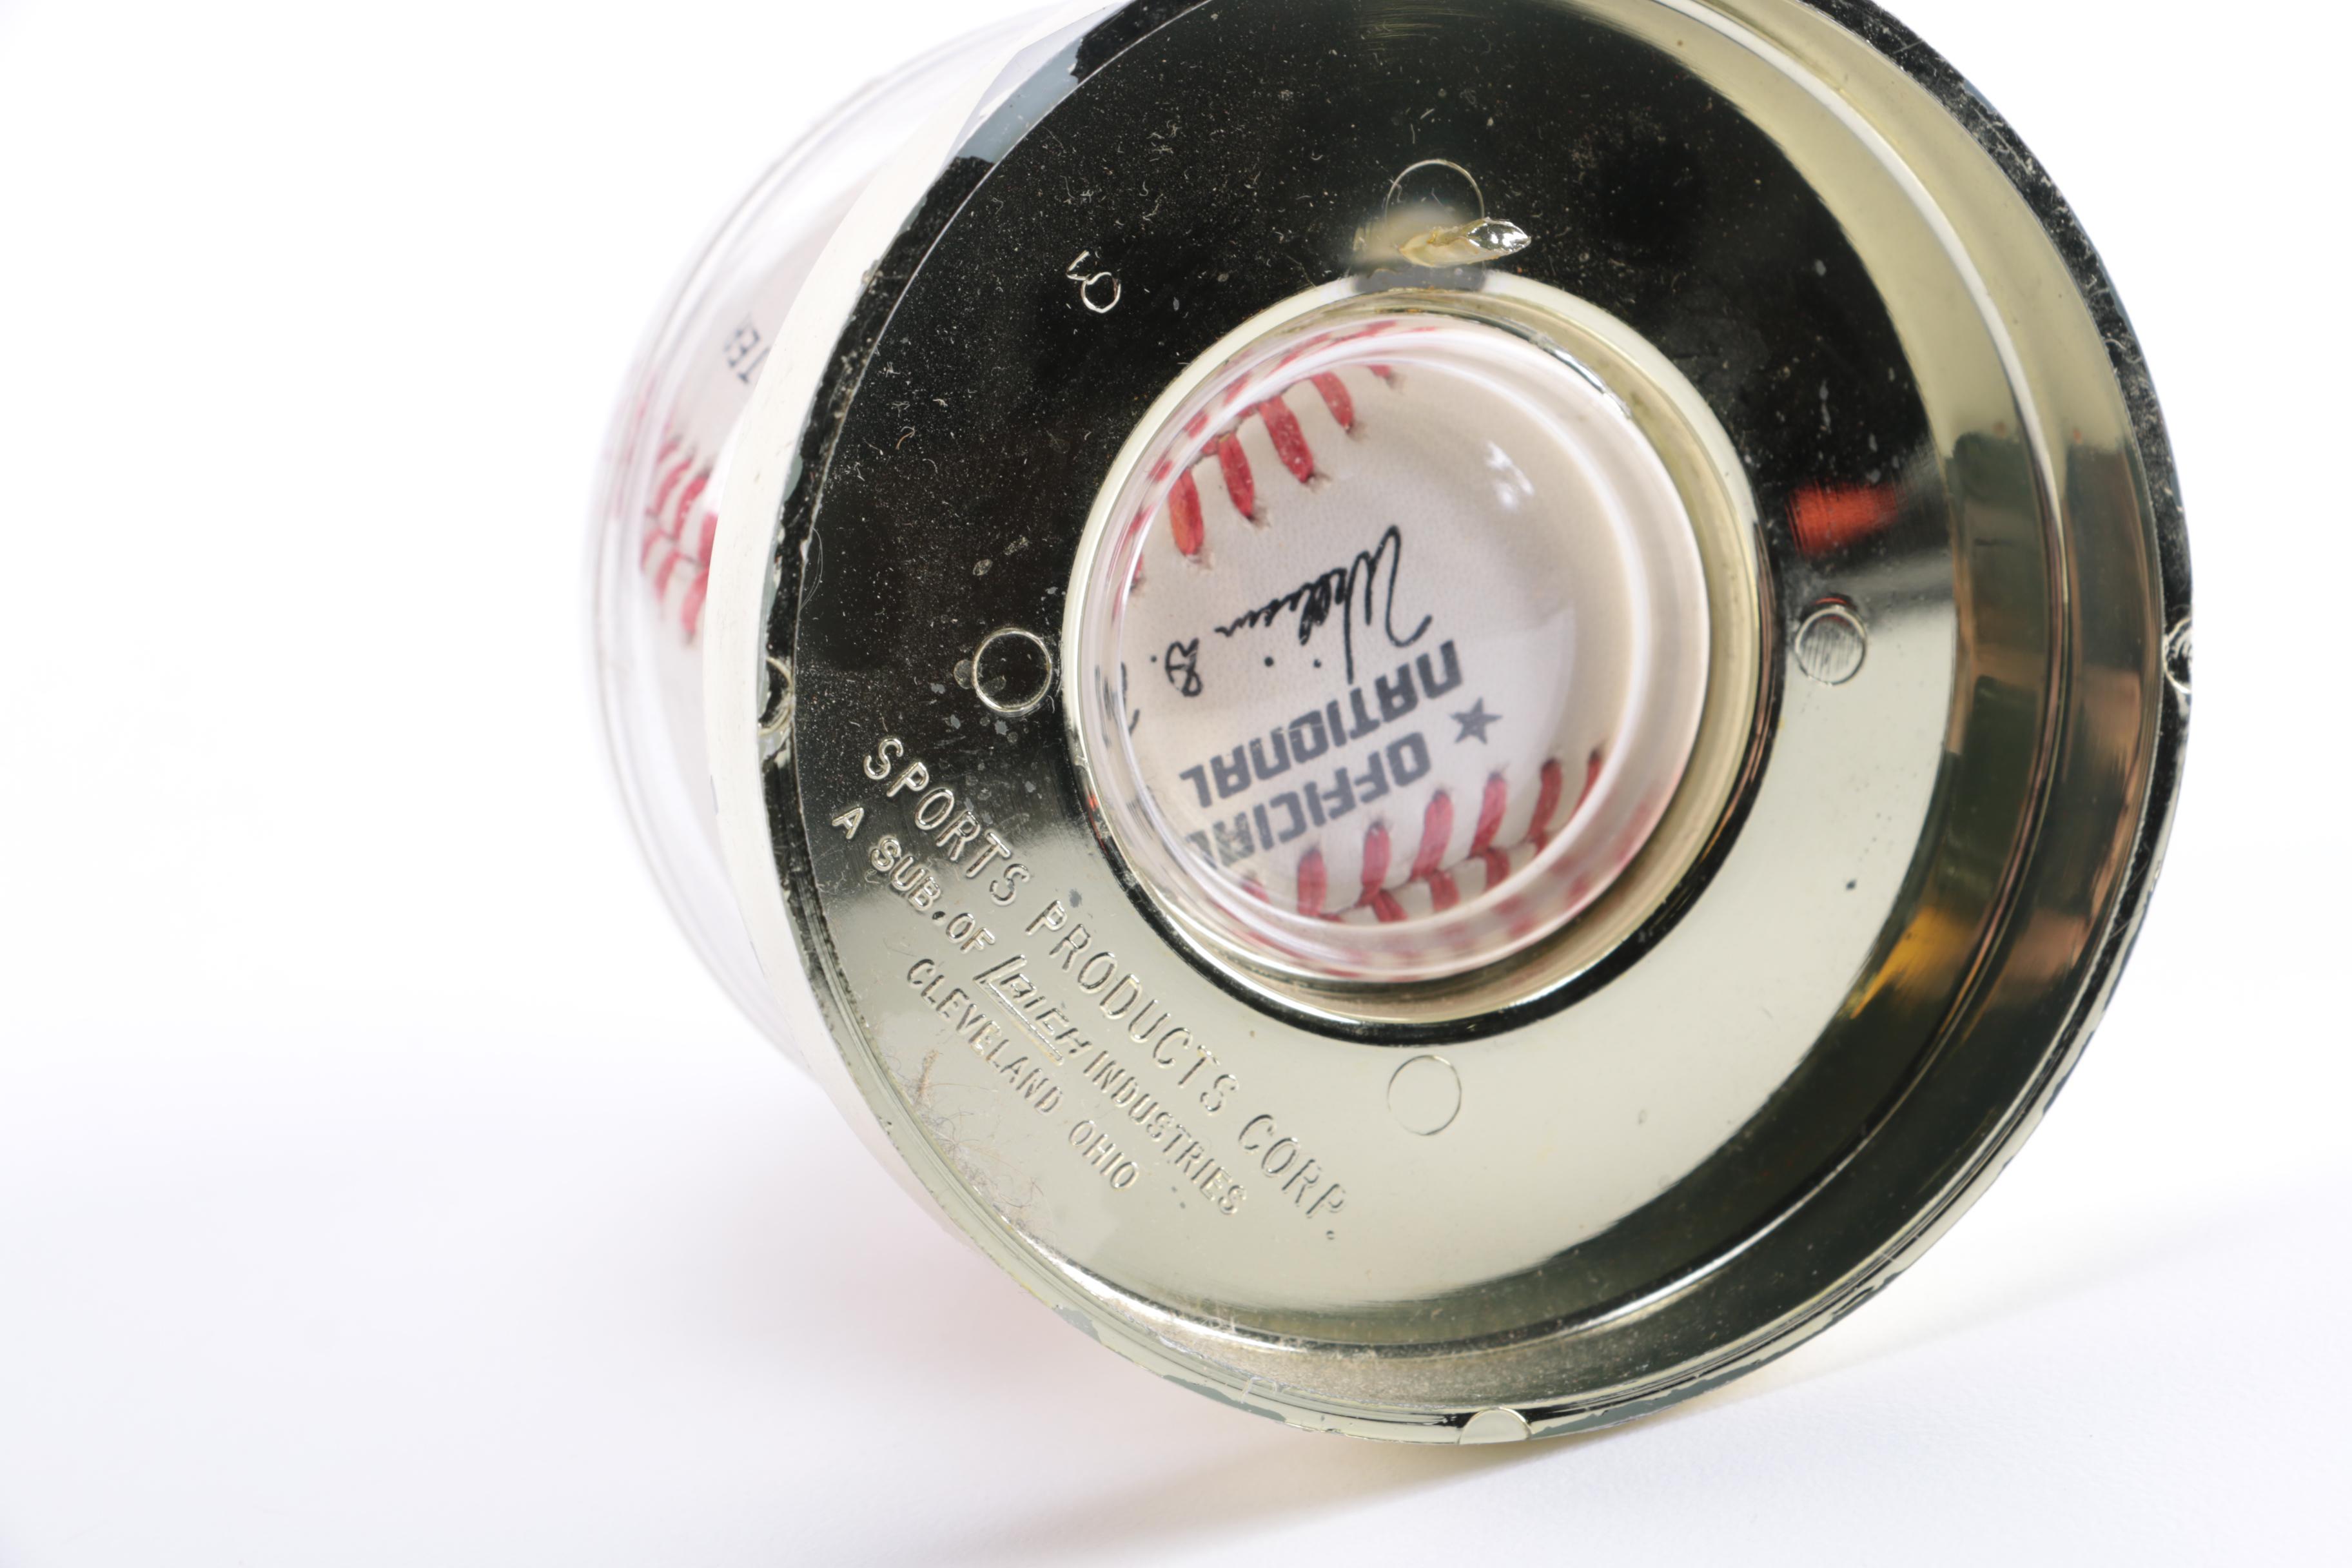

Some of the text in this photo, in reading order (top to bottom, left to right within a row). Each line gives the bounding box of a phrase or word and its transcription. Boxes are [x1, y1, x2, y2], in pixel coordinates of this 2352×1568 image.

[1179, 640, 1463, 808] NATIONAL
[832, 806, 866, 839] A
[1083, 1051, 1247, 1215] INDUSTRIES
[863, 737, 1346, 1240] SPORTS PRODUCTS CORP.
[906, 957, 1139, 1190] CLEVELAND OHIO
